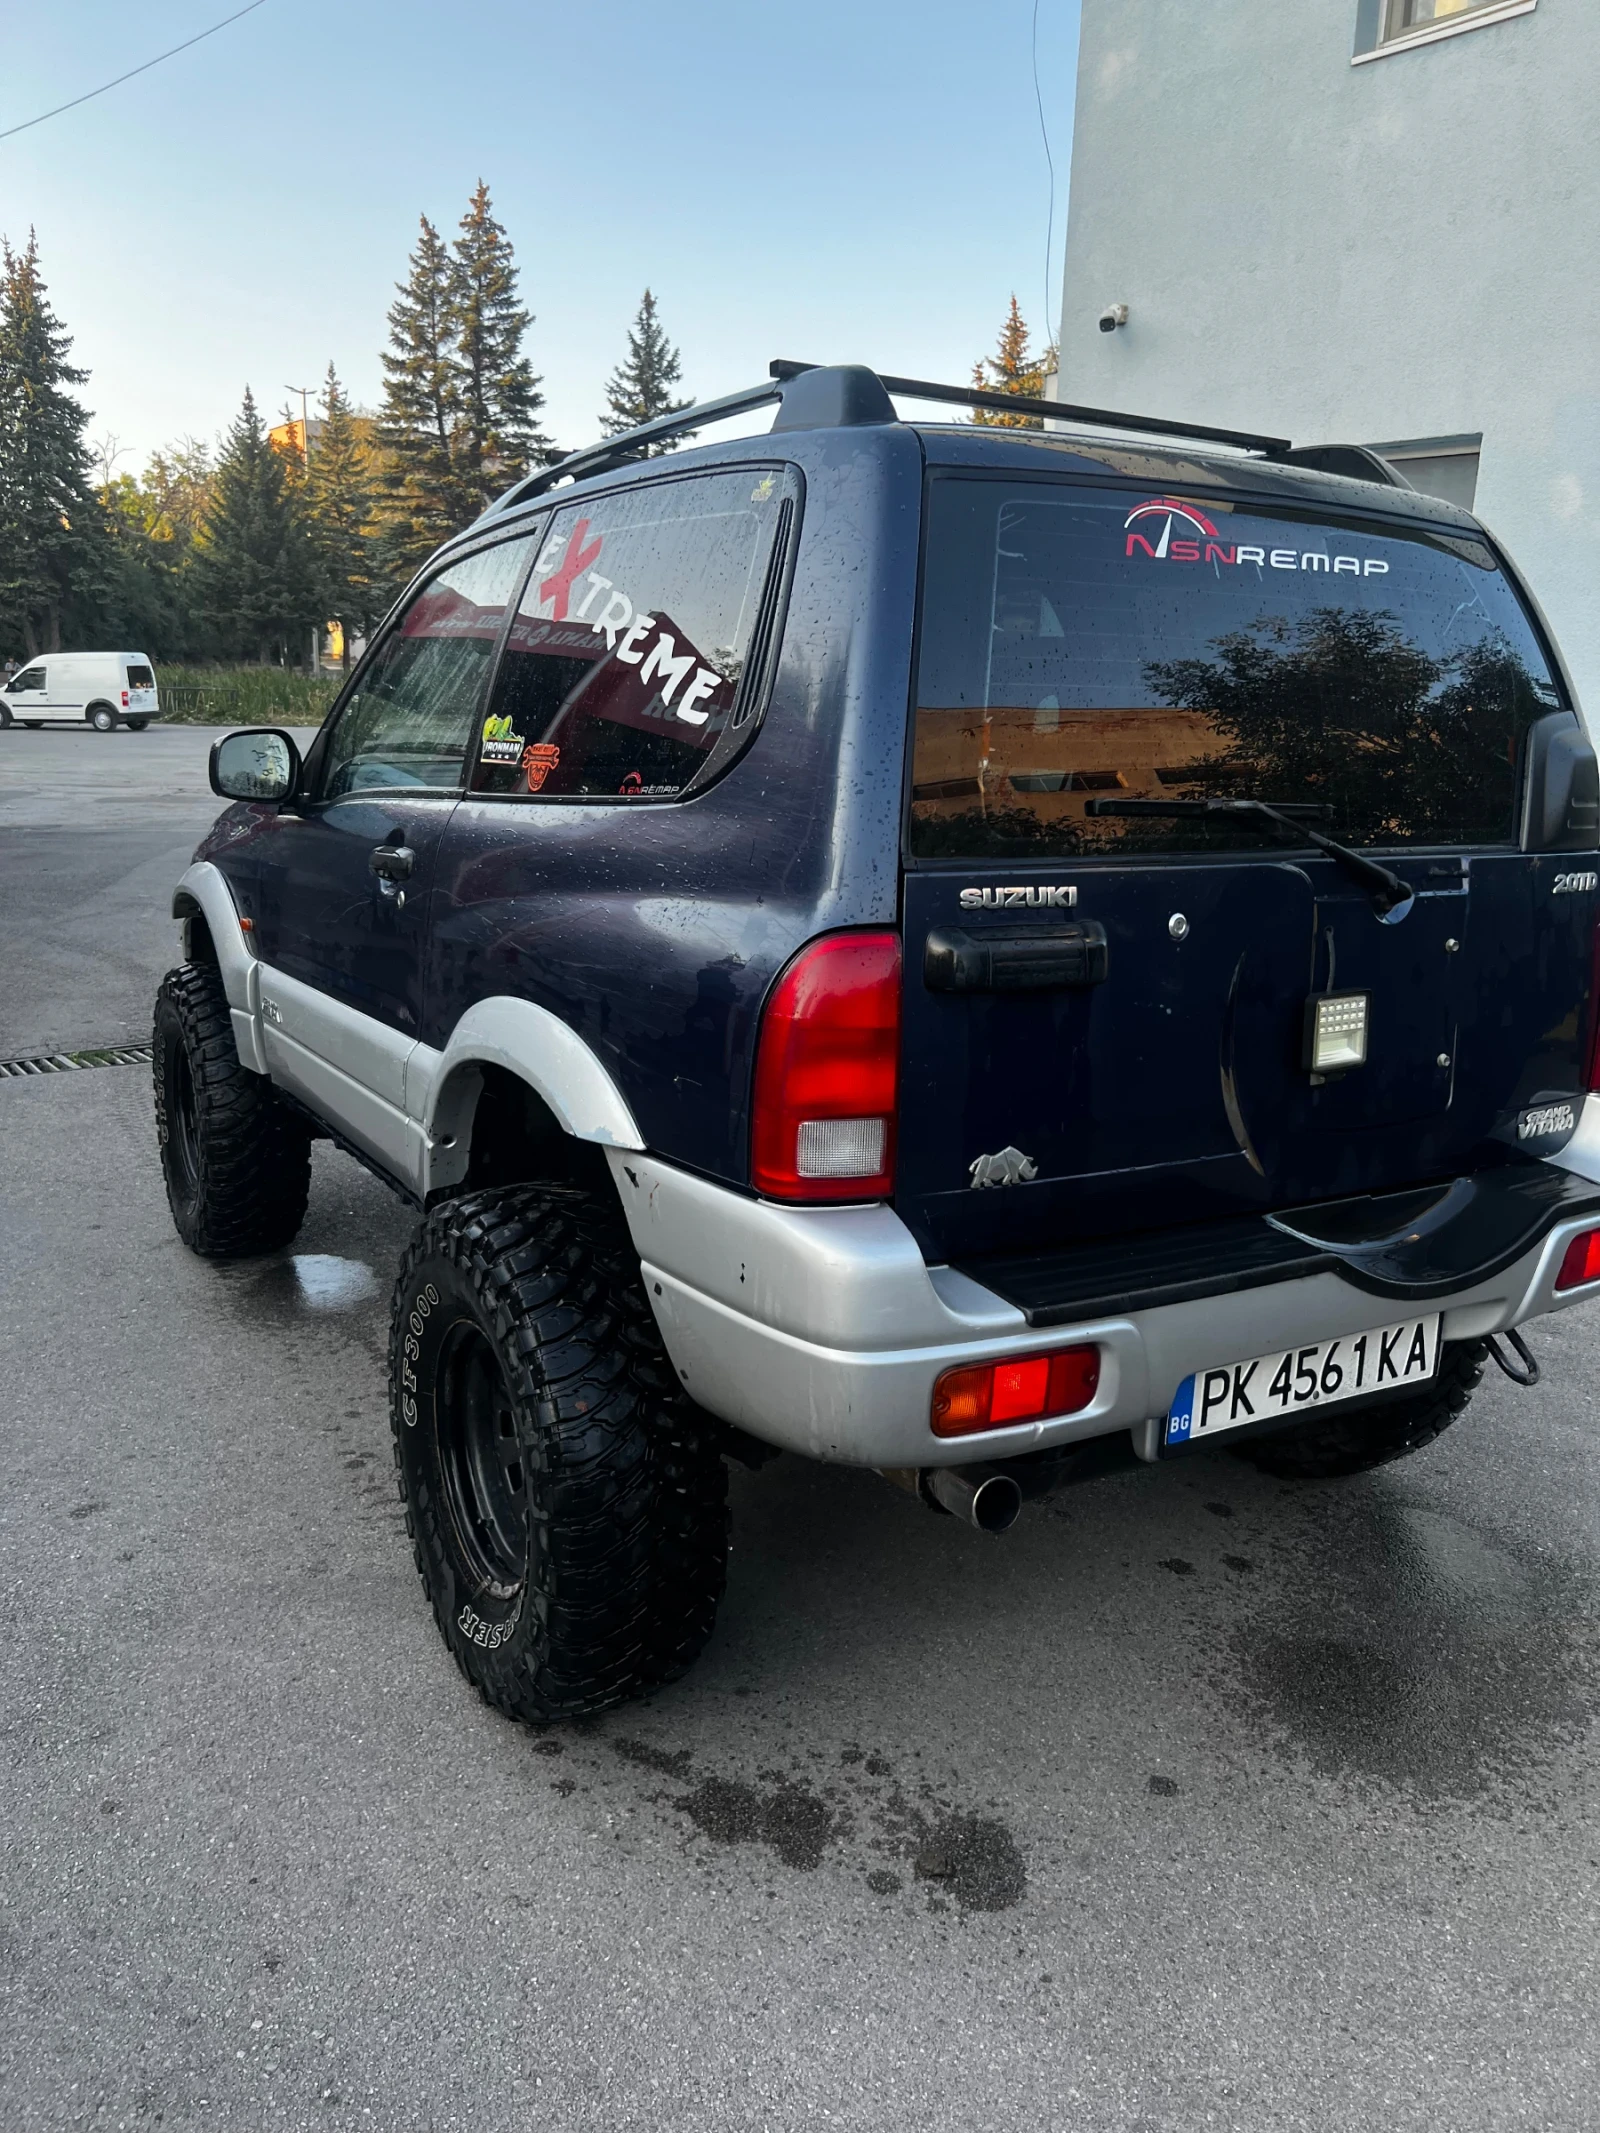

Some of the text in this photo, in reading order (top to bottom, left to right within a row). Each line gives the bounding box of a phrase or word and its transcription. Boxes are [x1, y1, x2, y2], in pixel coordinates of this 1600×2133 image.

[531, 518, 723, 726] EXTREME
[484, 741, 521, 753] IRONMAN
[959, 886, 1077, 909] SUZUKI
[1518, 1113, 1574, 1140] VITARA
[402, 1283, 439, 1427] CF3000
[1199, 1322, 1427, 1428] PK 4561 KA
[1169, 1414, 1190, 1433] BG
